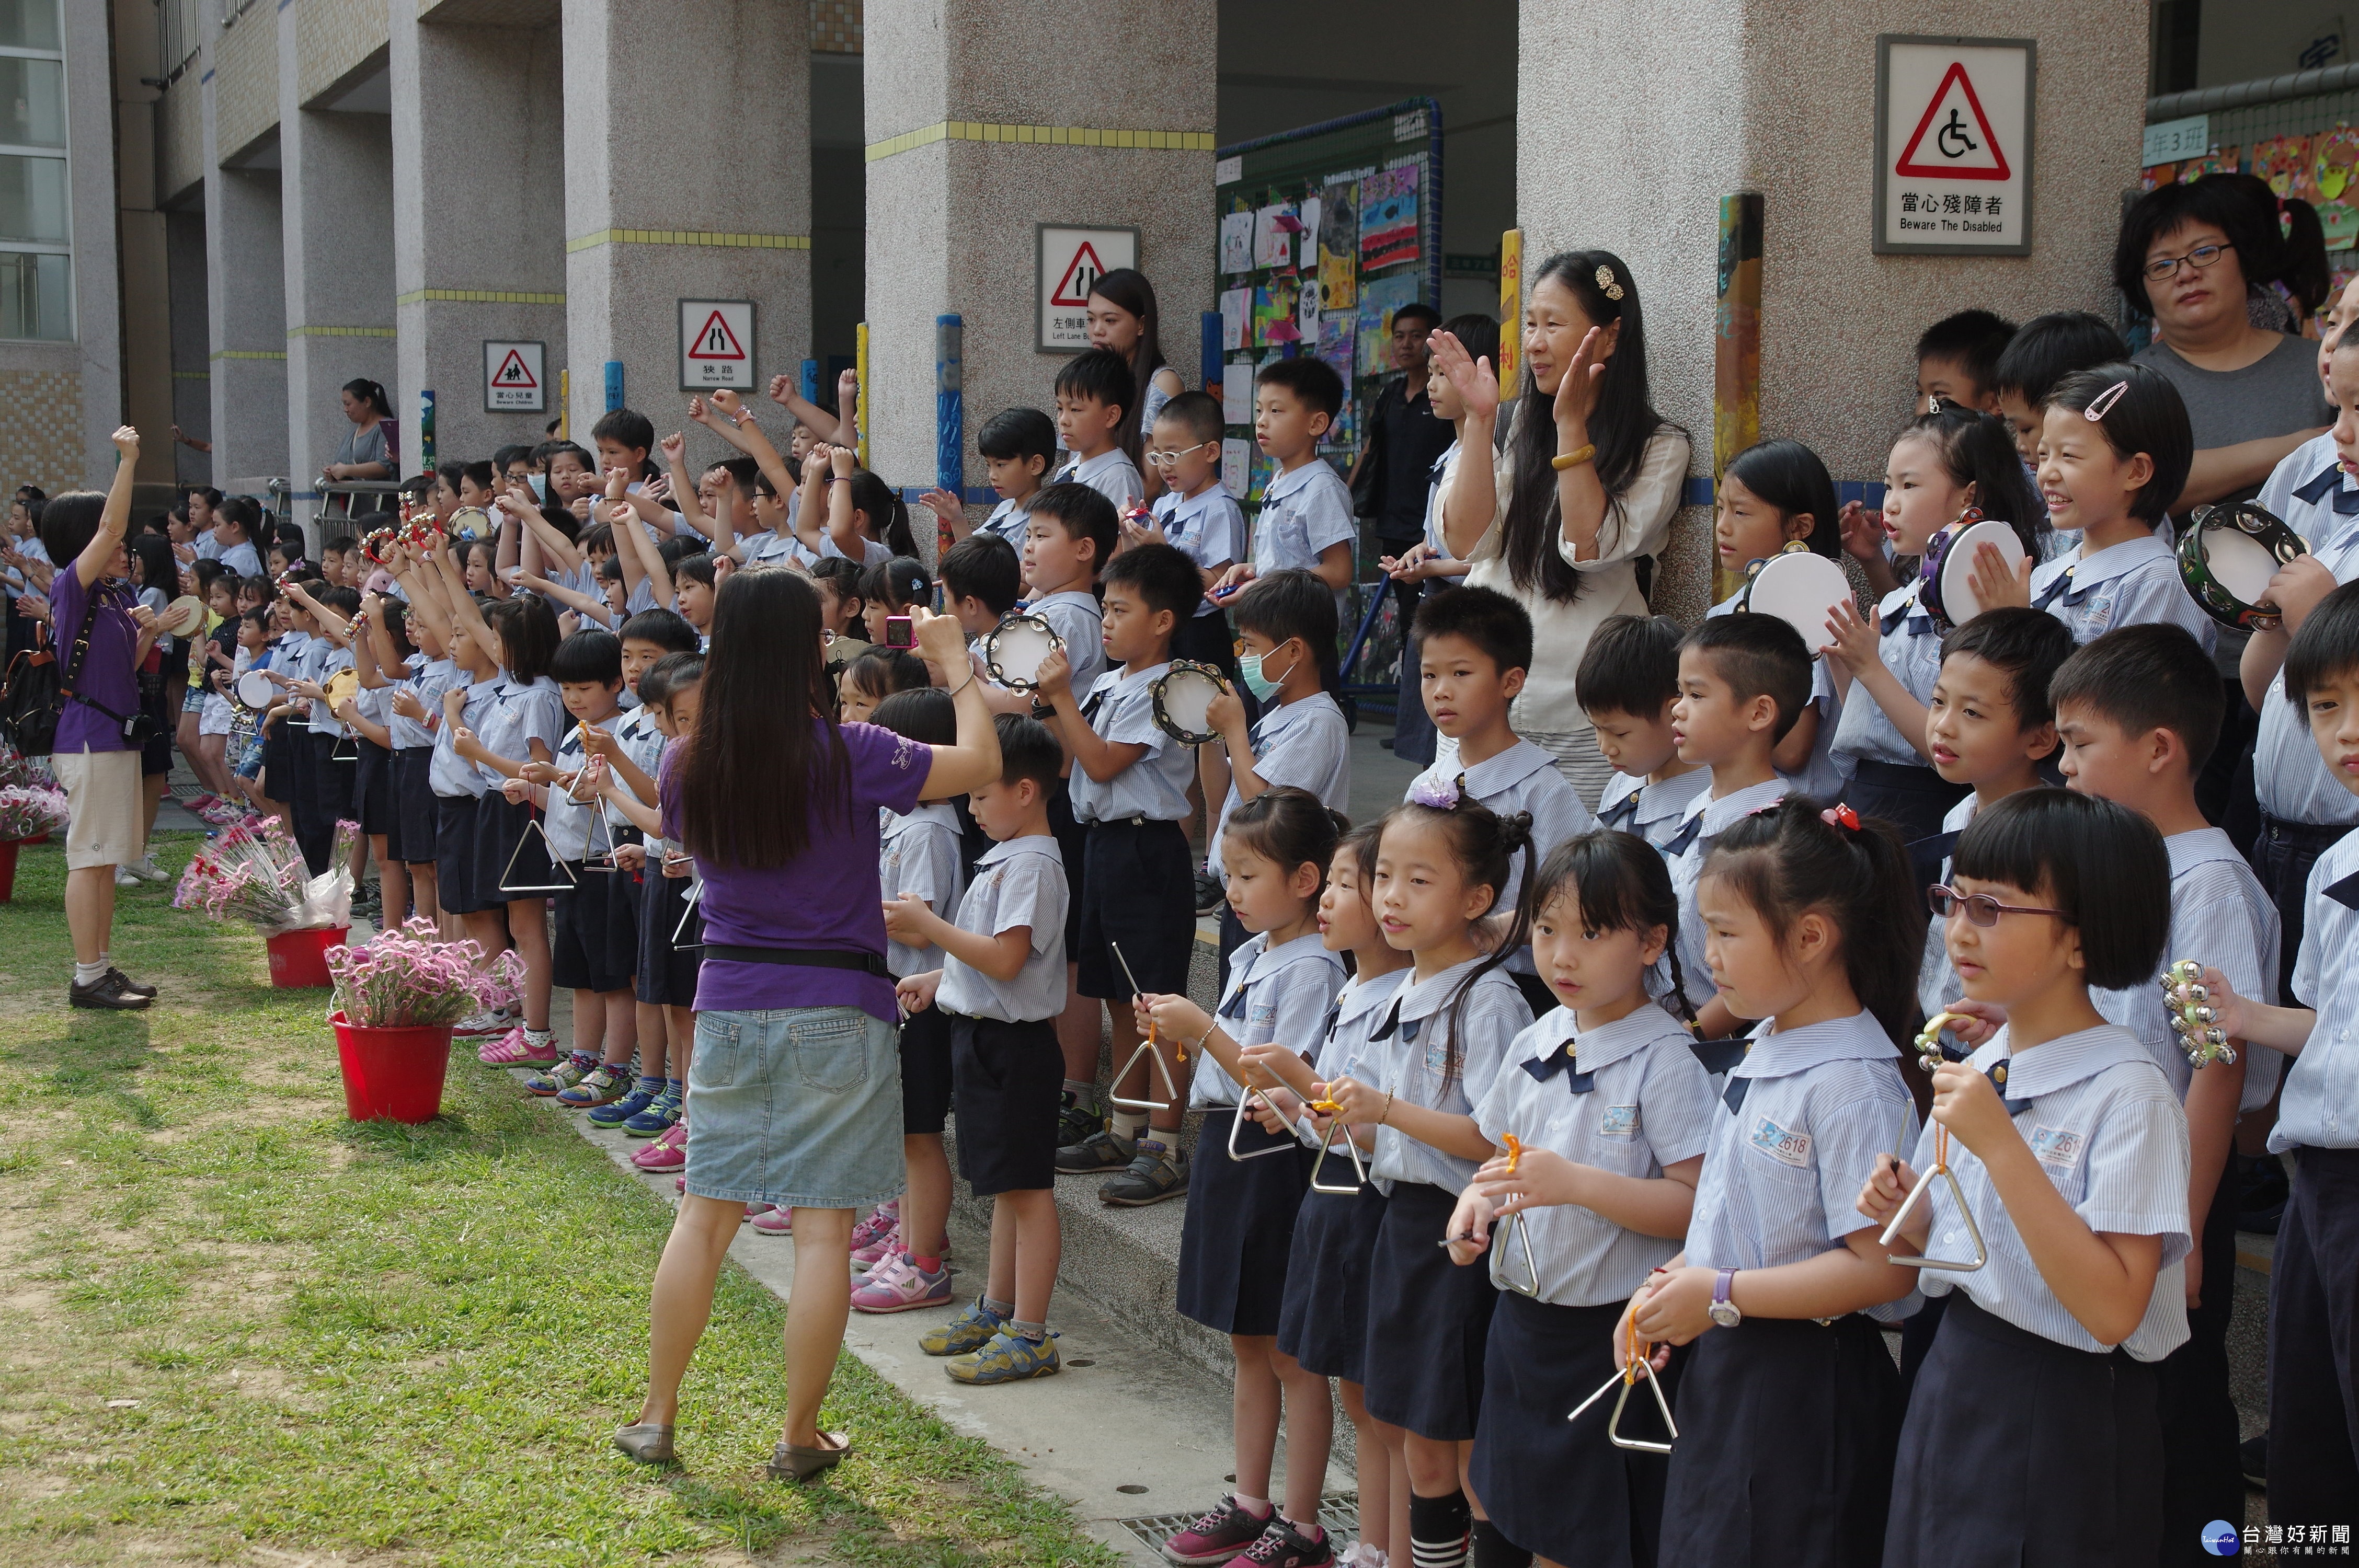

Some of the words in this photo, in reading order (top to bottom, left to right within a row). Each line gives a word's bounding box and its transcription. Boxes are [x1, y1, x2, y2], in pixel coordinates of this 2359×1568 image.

[1902, 192, 2002, 215] 當心殘障者
[1900, 218, 1936, 230] Beware
[1941, 220, 1958, 230] The
[1963, 221, 2002, 232] Disabled
[1053, 317, 1087, 329] 左側車
[1778, 1134, 1806, 1153] 2618
